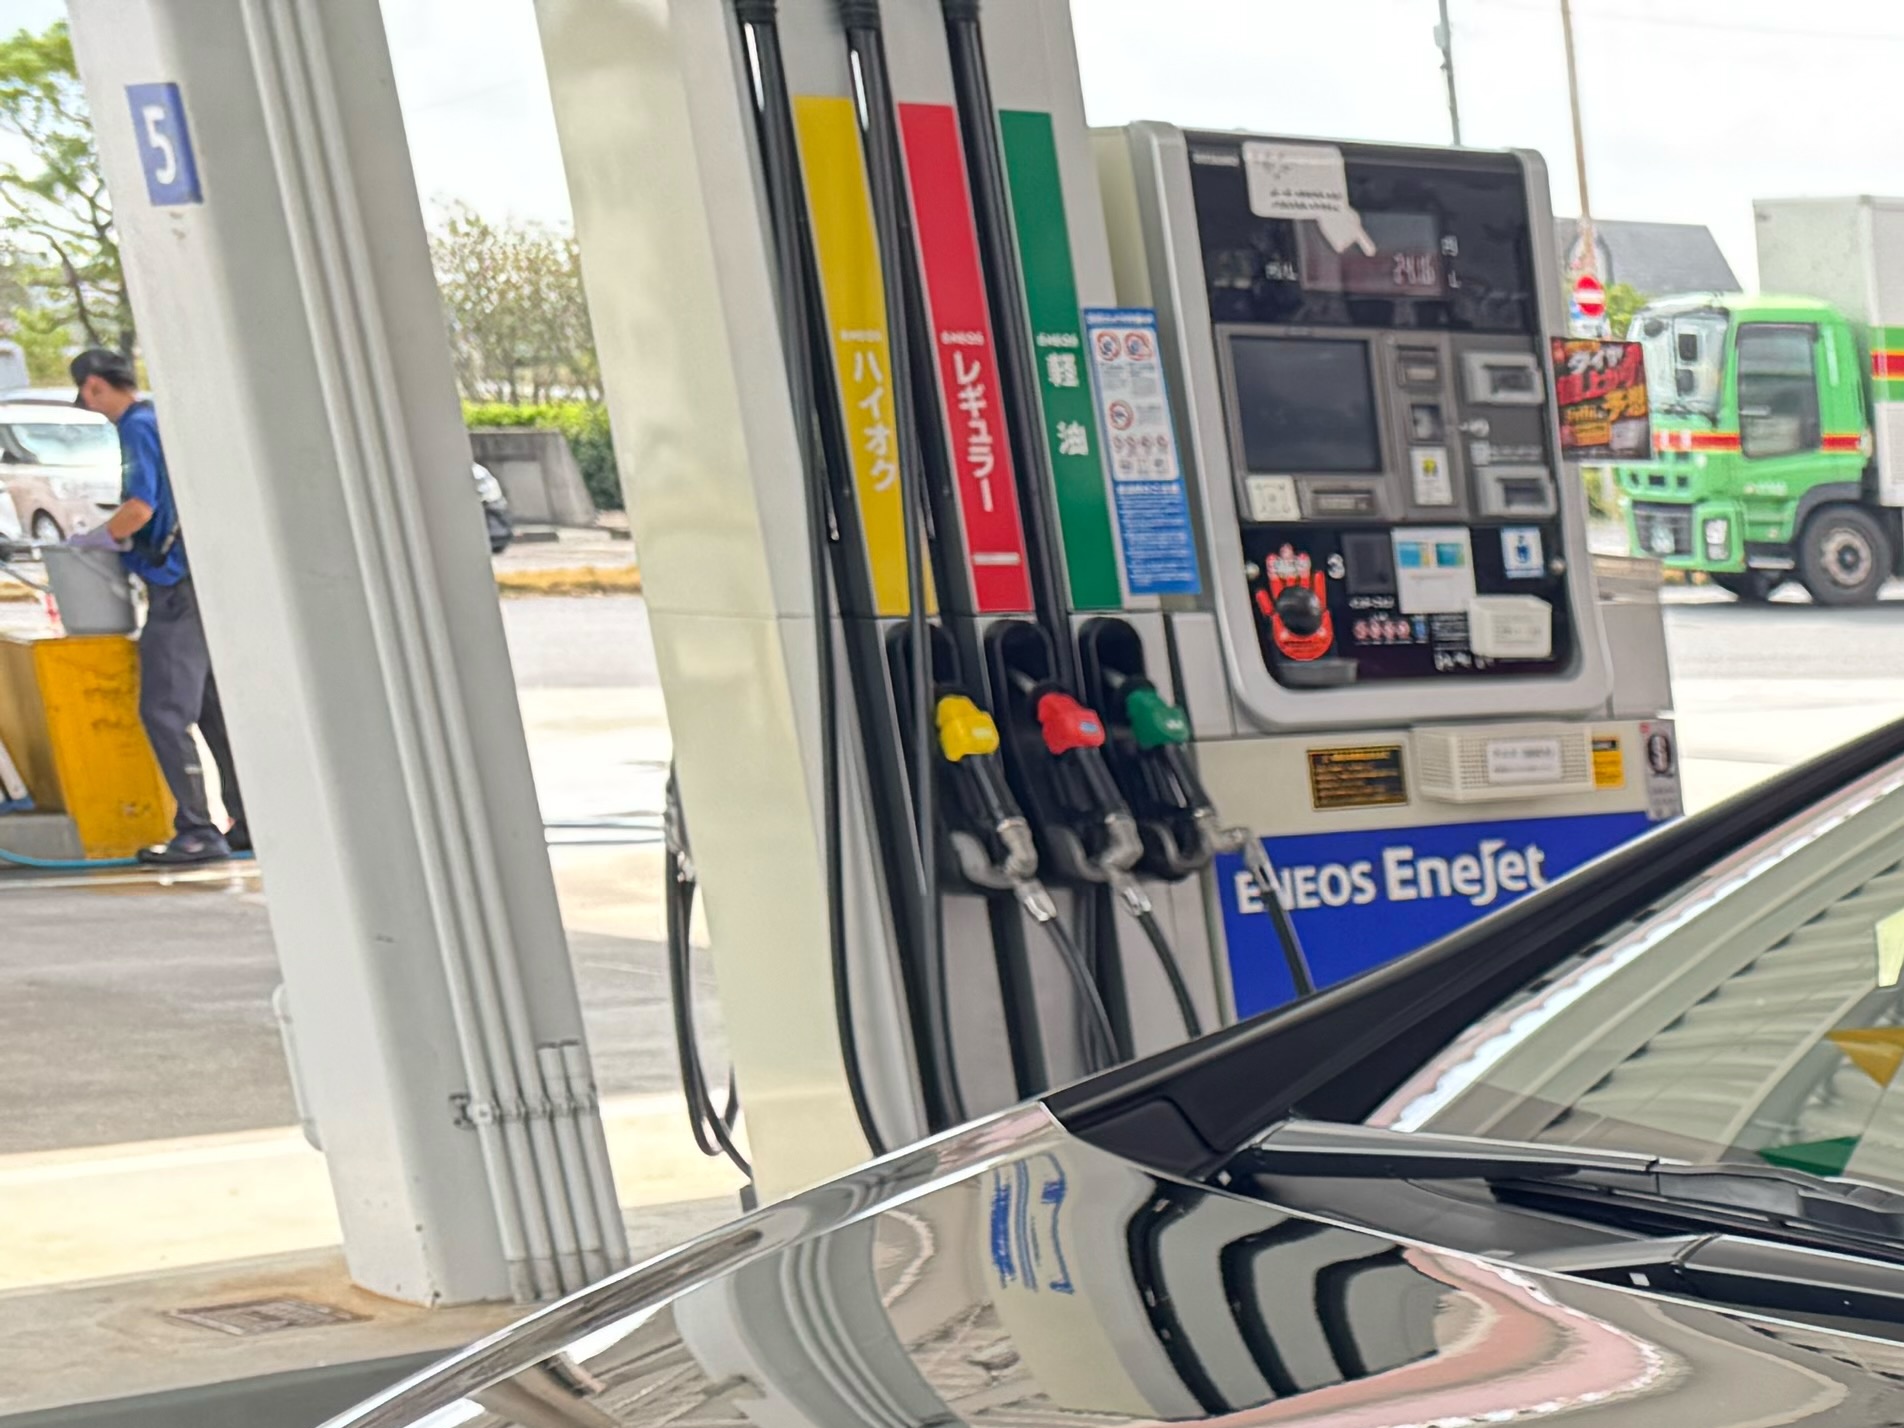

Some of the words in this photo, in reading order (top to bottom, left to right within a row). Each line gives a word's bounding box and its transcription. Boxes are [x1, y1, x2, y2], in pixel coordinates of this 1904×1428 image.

[141, 105, 177, 185] 5
[852, 351, 897, 493] ハイオク
[953, 350, 995, 512] レギュラー
[1045, 352, 1089, 456] 軽油
[1234, 860, 1377, 914] ENEOS
[1382, 839, 1549, 906] EneJet
